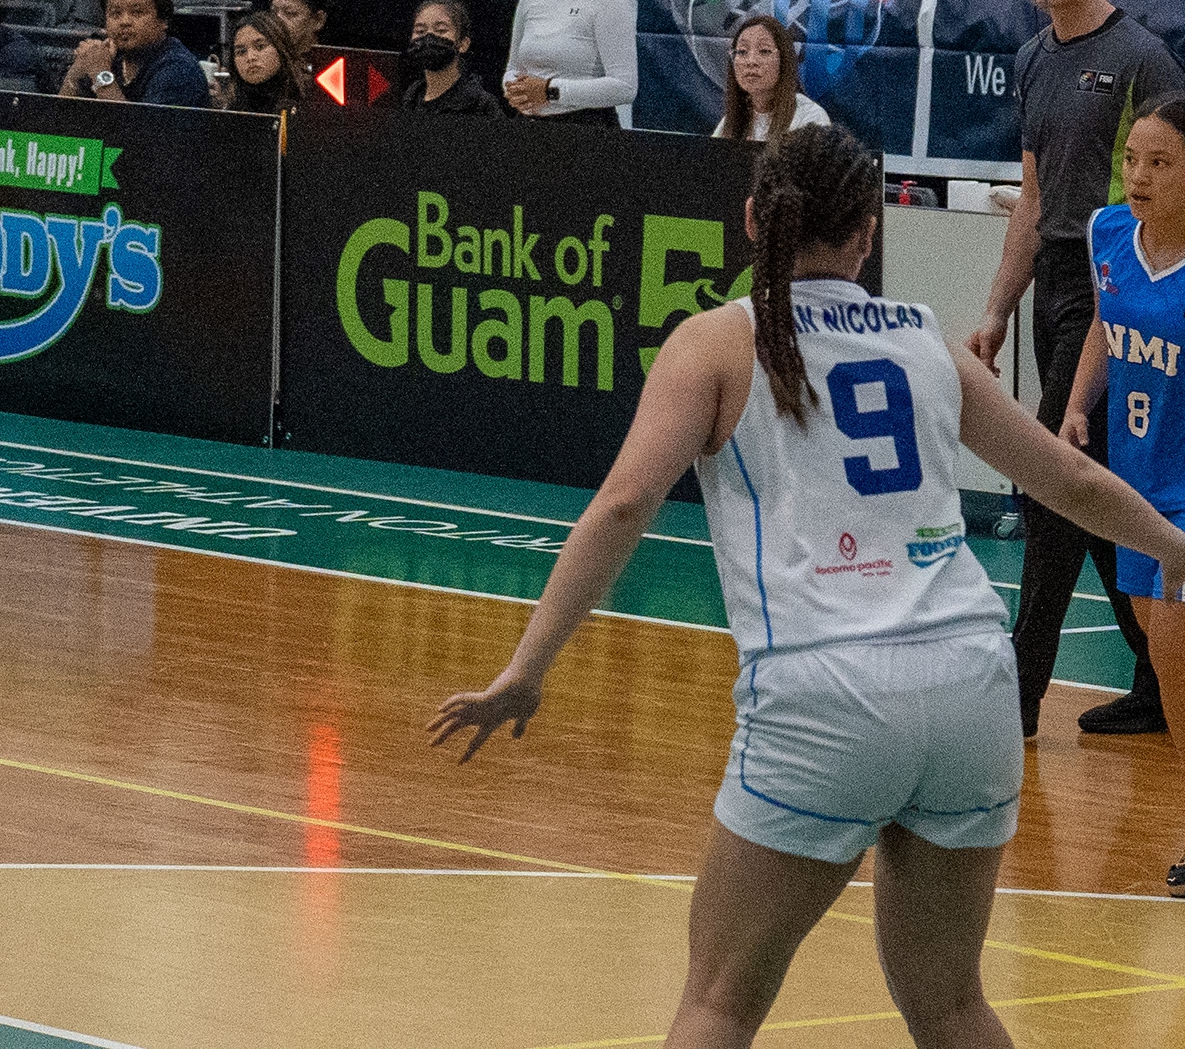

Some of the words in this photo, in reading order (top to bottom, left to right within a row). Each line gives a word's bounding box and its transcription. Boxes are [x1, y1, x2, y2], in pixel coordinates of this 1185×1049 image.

[965, 54, 1006, 97] We
[27, 141, 85, 187] Happy!
[418, 191, 542, 281] Bank
[554, 214, 615, 287] of
[337, 217, 615, 391] Guam
[1102, 321, 1182, 377] NMI
[827, 359, 923, 497] 9
[1126, 391, 1152, 439] 8
